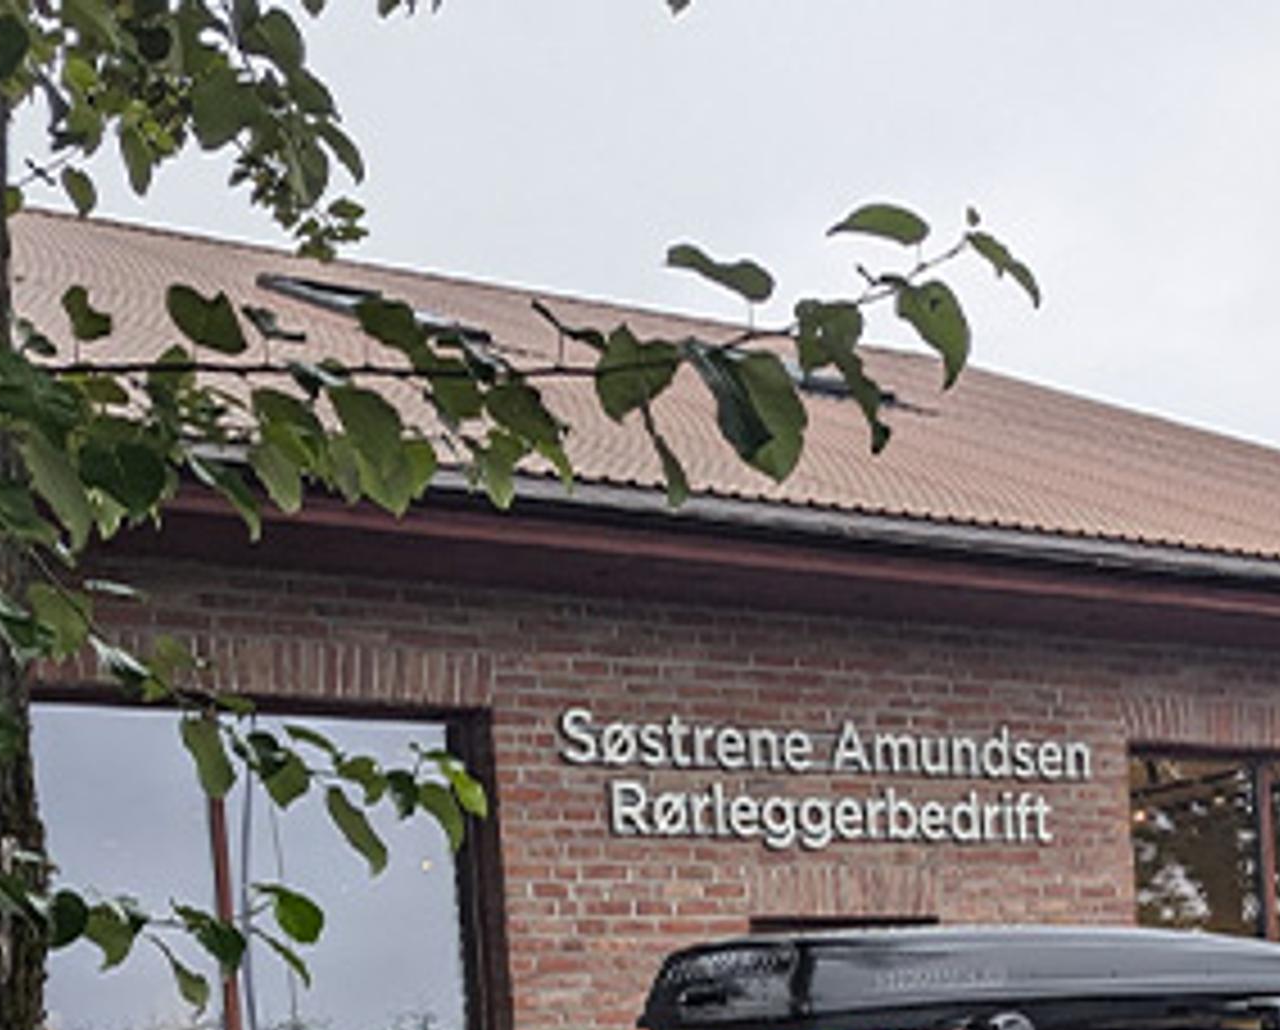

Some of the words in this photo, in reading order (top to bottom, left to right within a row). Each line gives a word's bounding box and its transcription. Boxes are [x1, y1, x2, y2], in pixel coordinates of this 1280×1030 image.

[560, 708, 813, 769] Søstrene
[833, 720, 1092, 779] Amundsen
[611, 780, 1054, 848] Rørleggerbedrift
